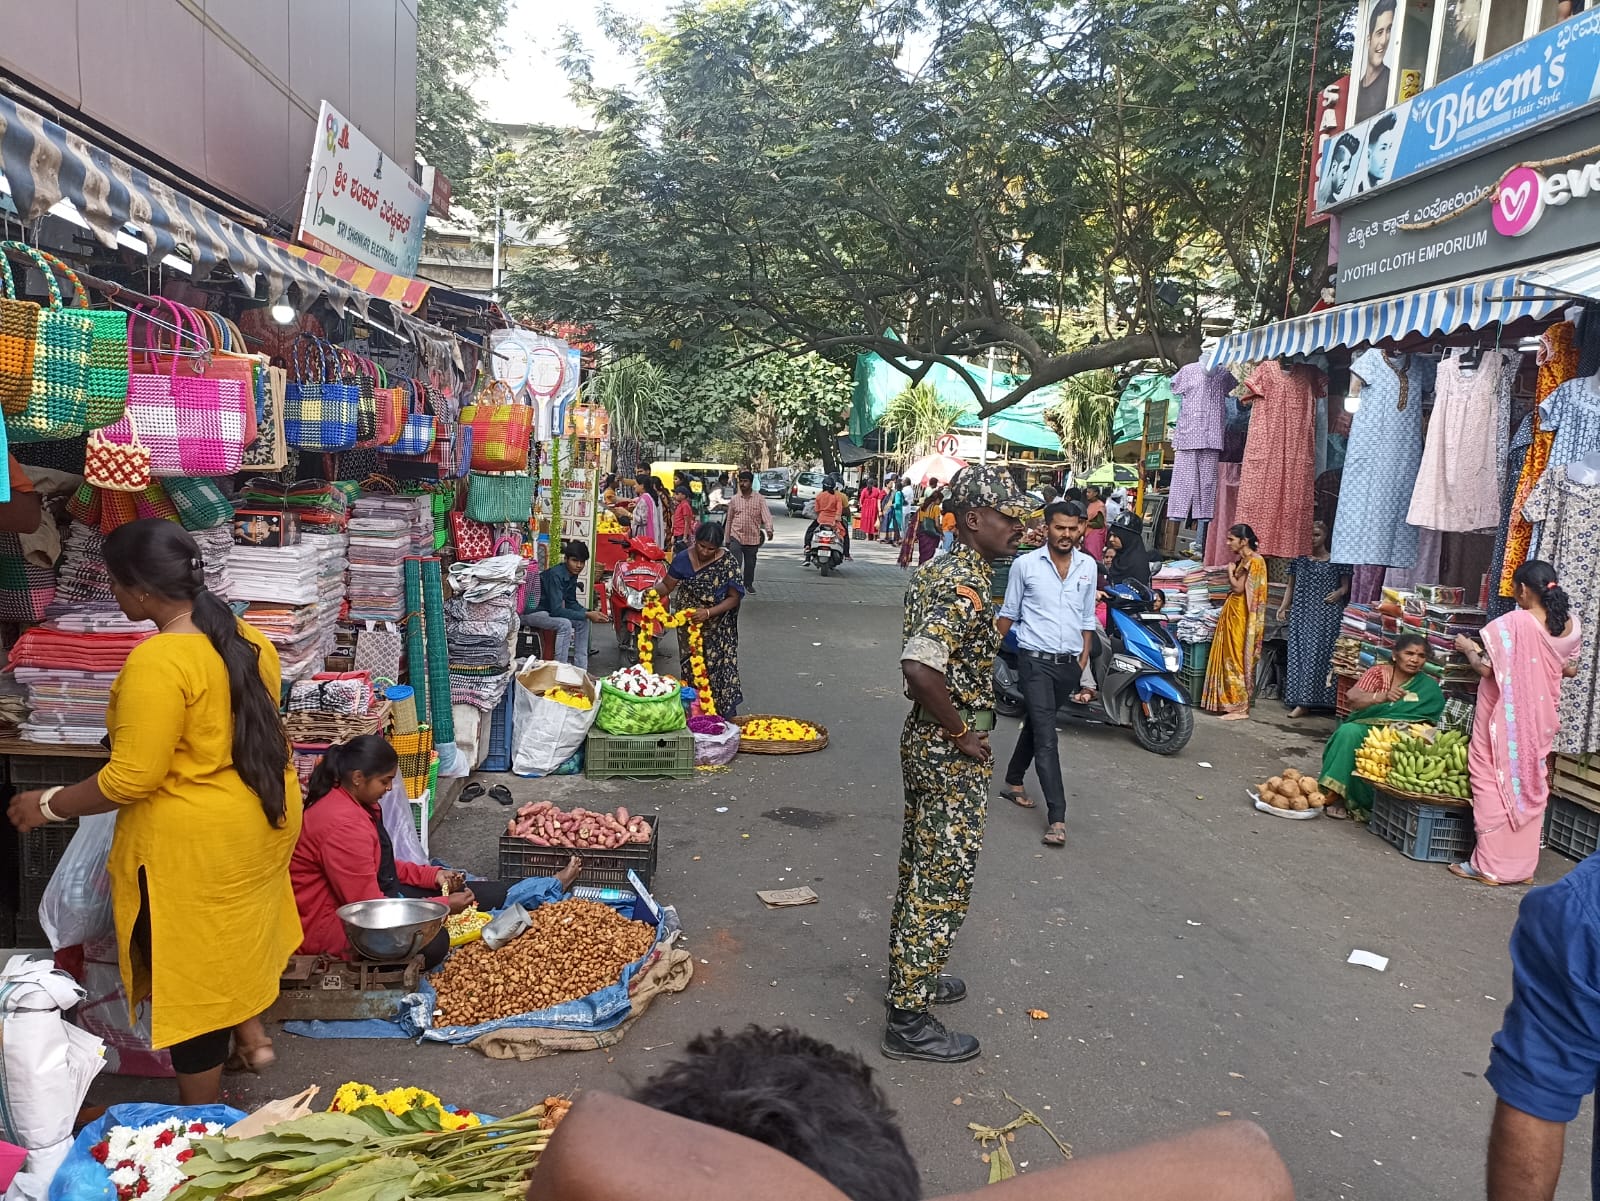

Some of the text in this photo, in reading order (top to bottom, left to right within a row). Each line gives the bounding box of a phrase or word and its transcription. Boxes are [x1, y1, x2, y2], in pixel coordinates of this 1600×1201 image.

[1426, 45, 1567, 151] Bheem's
[1512, 103, 1535, 120] Hair
[1535, 91, 1561, 112] Style
[337, 221, 348, 239] SRI
[1347, 222, 1379, 249] ಜ್ಯೋತಿ
[1342, 230, 1488, 283] JYOTHI CLOTH EMPORIUM
[1115, 659, 1137, 673] 125
